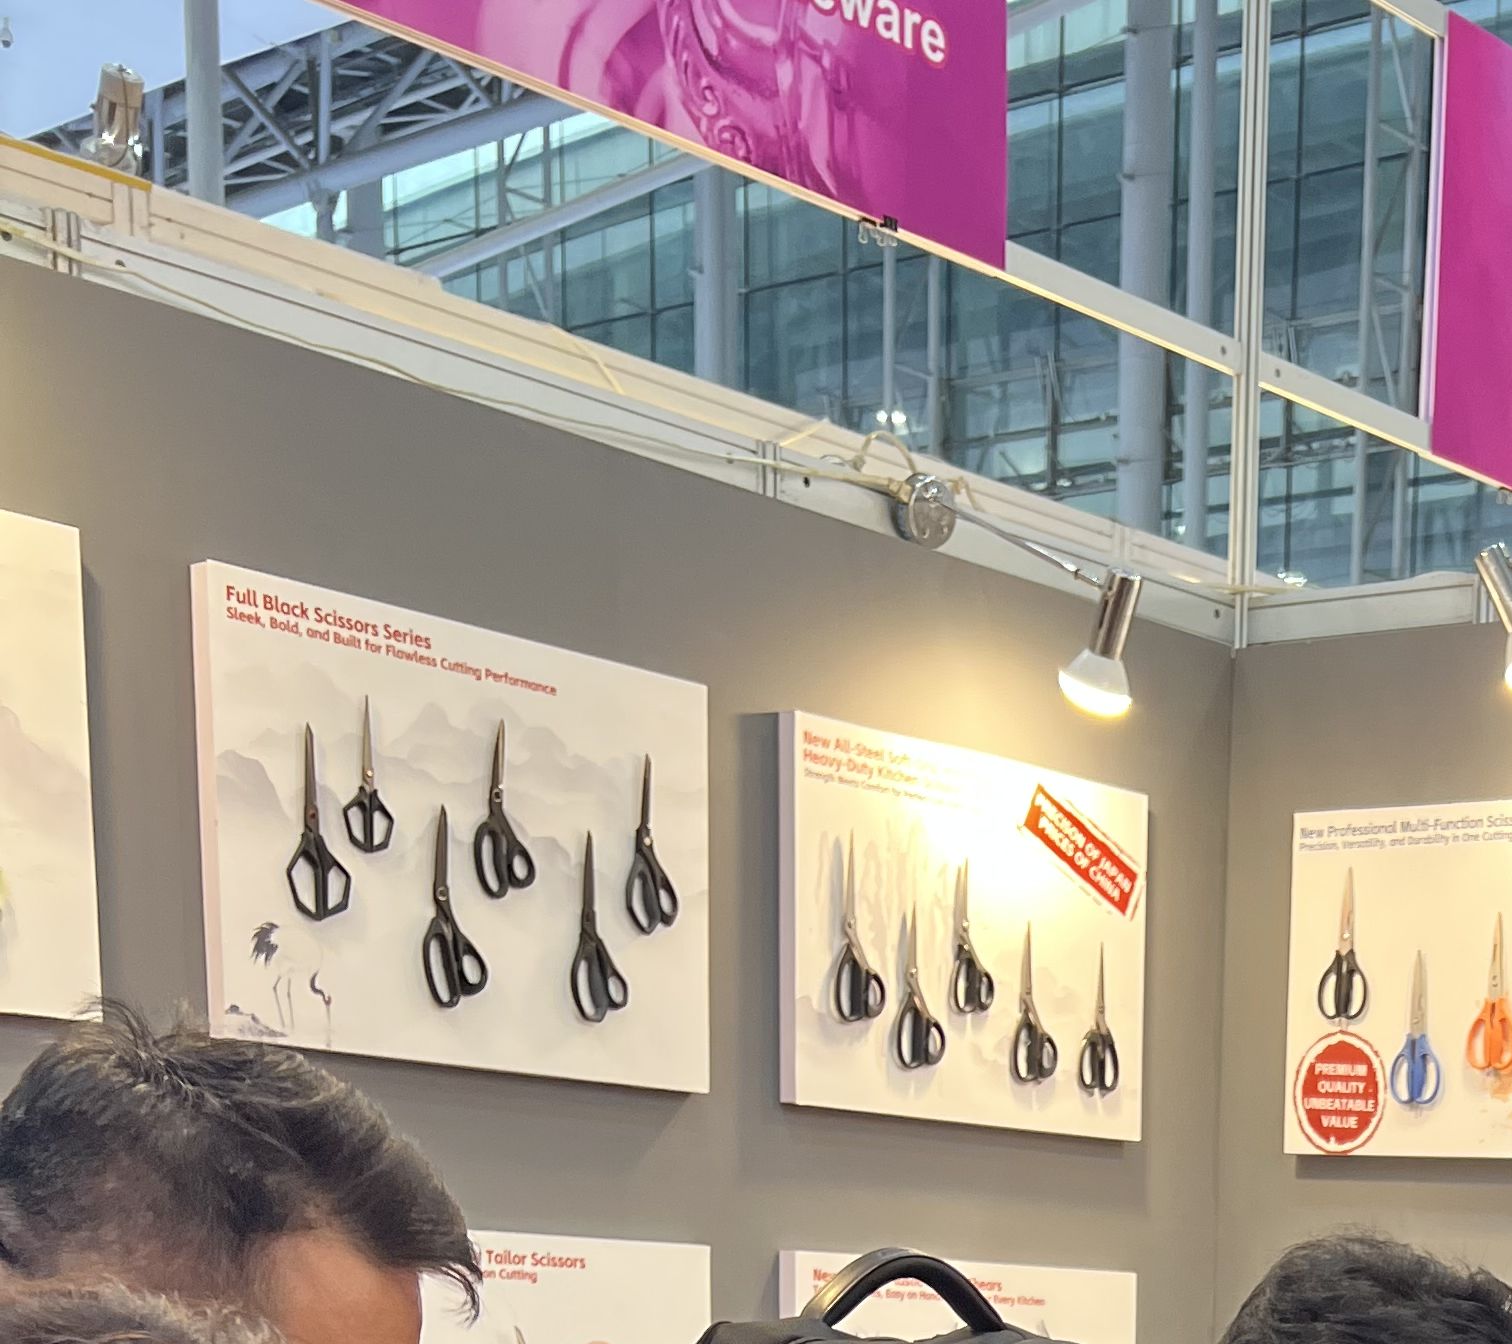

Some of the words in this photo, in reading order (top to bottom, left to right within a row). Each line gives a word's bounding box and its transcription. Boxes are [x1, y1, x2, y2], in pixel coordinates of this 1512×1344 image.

[811, 0, 946, 64] ware
[226, 585, 258, 608] Full
[262, 594, 310, 620] Black
[314, 607, 379, 637] Scissors
[383, 624, 432, 650] Series
[226, 606, 266, 628] Sleek,
[269, 617, 303, 637] Bold,
[306, 627, 330, 642] and
[333, 632, 361, 650] Built
[365, 639, 382, 654] for
[386, 644, 438, 668] Flawless
[440, 658, 483, 681] Cutting
[485, 668, 558, 696] Performance
[803, 749, 874, 780] Heavy-Duty
[1300, 827, 1325, 839] New
[1327, 821, 1397, 837] Professional
[1400, 817, 1484, 833] Multi-Function
[1389, 838, 1405, 846] and
[1462, 833, 1480, 842] One
[1088, 865, 1121, 902] CHINA
[1314, 1063, 1369, 1077] PREMIUM
[1317, 1080, 1367, 1094] QUALITY
[1303, 1097, 1376, 1112] UNBEATABLE
[1320, 1115, 1359, 1129] VALUE
[486, 1249, 527, 1265] Tailor
[531, 1251, 586, 1269] Scissors
[499, 1268, 538, 1284] Cutting
